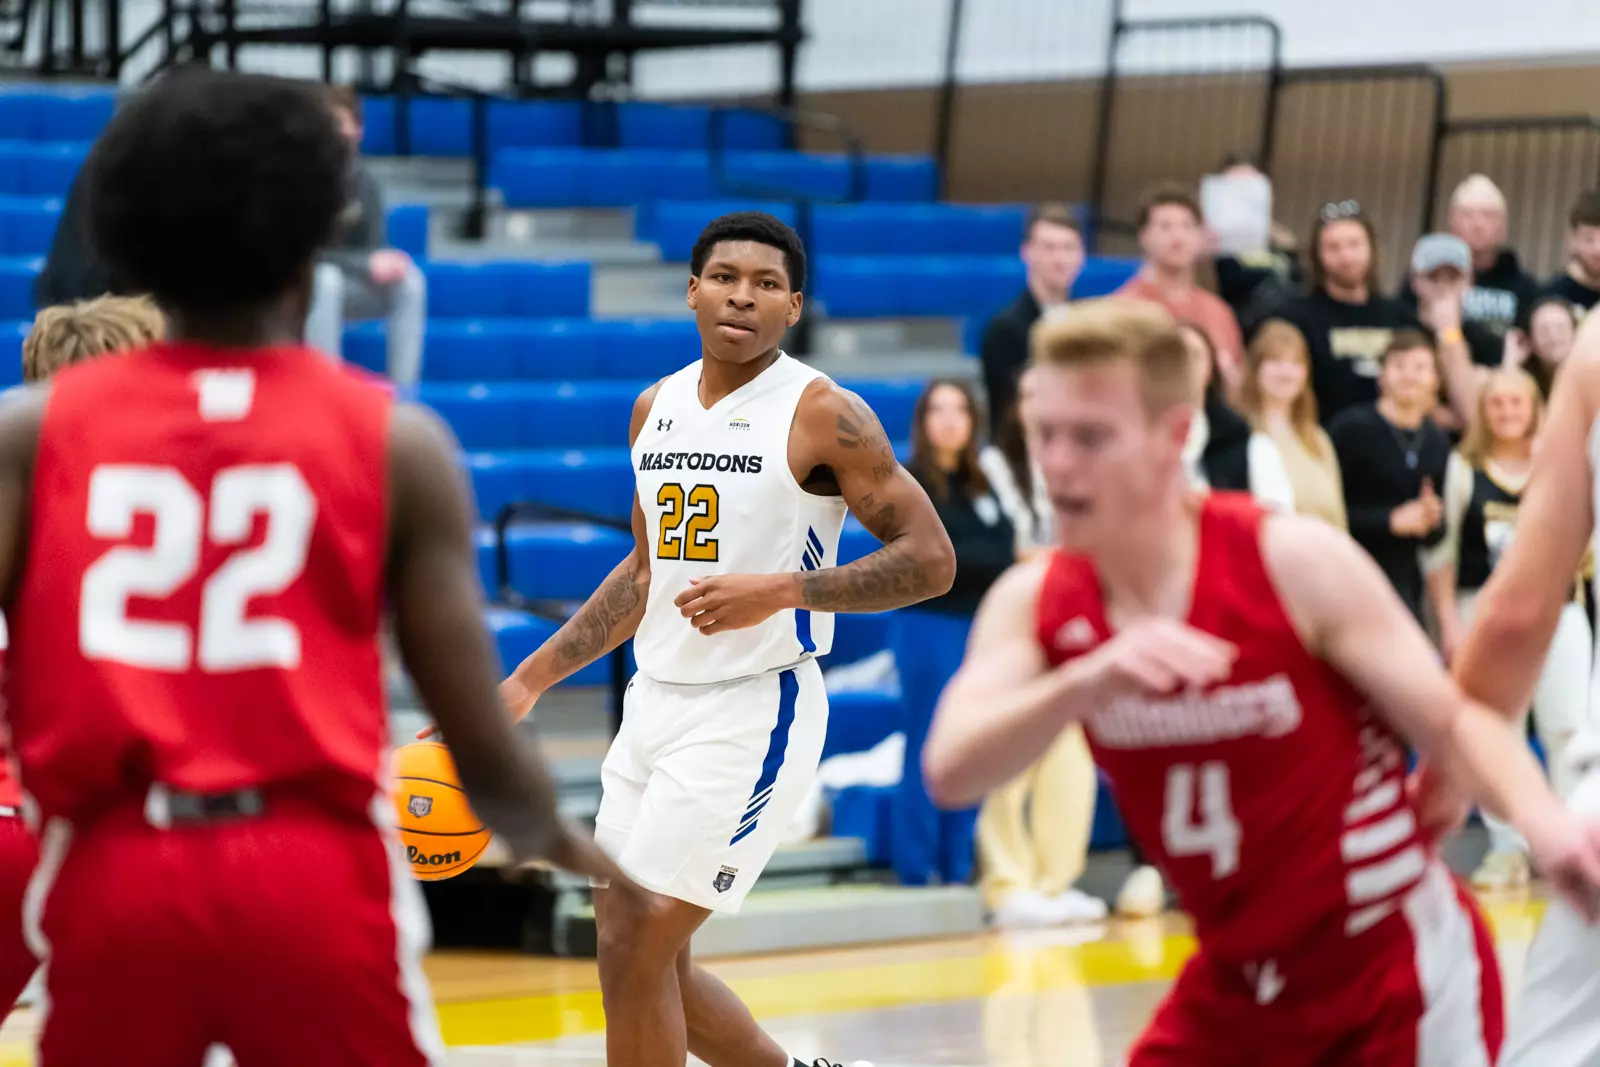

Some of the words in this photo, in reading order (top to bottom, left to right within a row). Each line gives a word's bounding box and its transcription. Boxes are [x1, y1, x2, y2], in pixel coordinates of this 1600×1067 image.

[639, 453, 763, 474] MASTODONS
[657, 483, 719, 562] 22
[79, 462, 319, 675] 22
[406, 845, 461, 866] lson
[1161, 760, 1243, 880] 4
